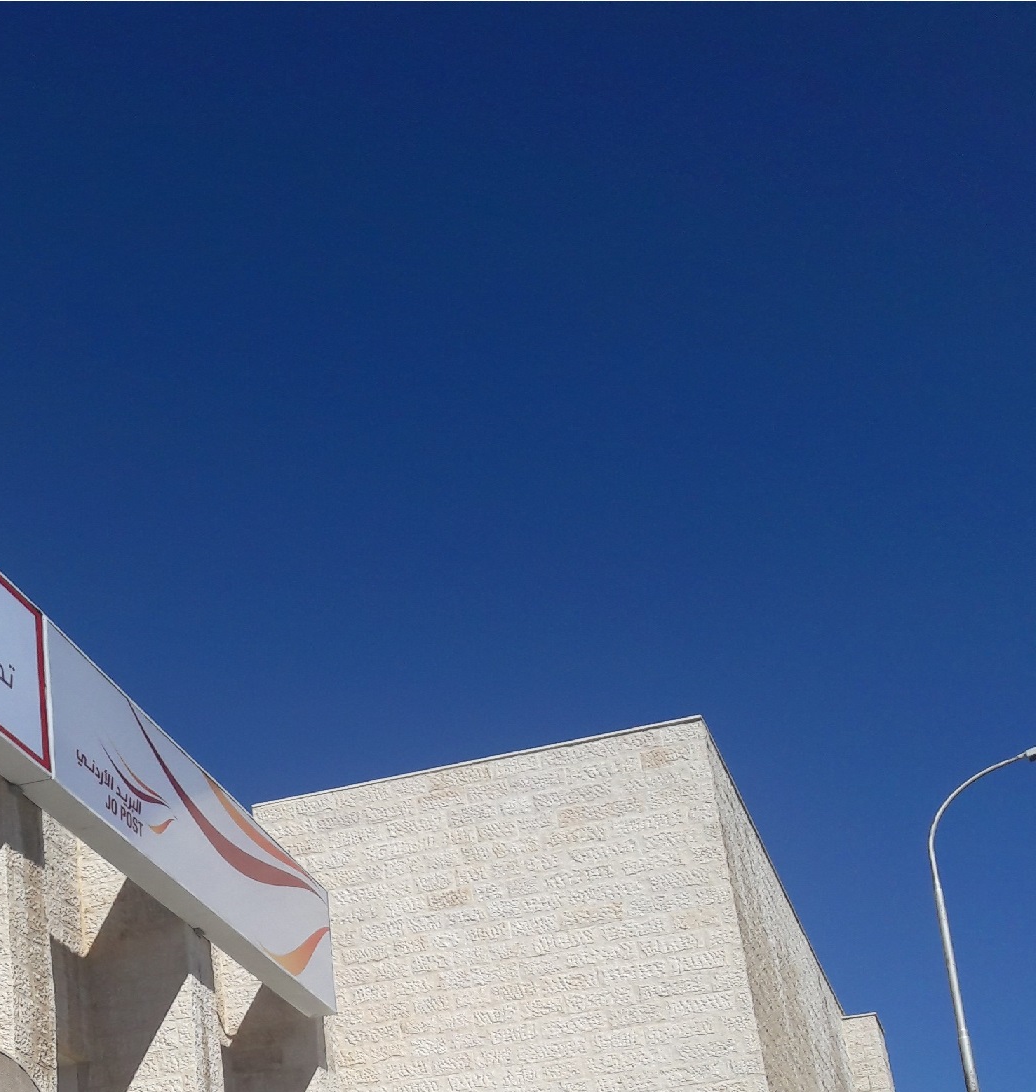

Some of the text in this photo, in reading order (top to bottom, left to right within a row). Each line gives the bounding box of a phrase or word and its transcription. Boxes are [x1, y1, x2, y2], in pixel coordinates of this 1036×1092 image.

[76, 748, 142, 815] البريد الأردني
[105, 794, 144, 838] JO POST
